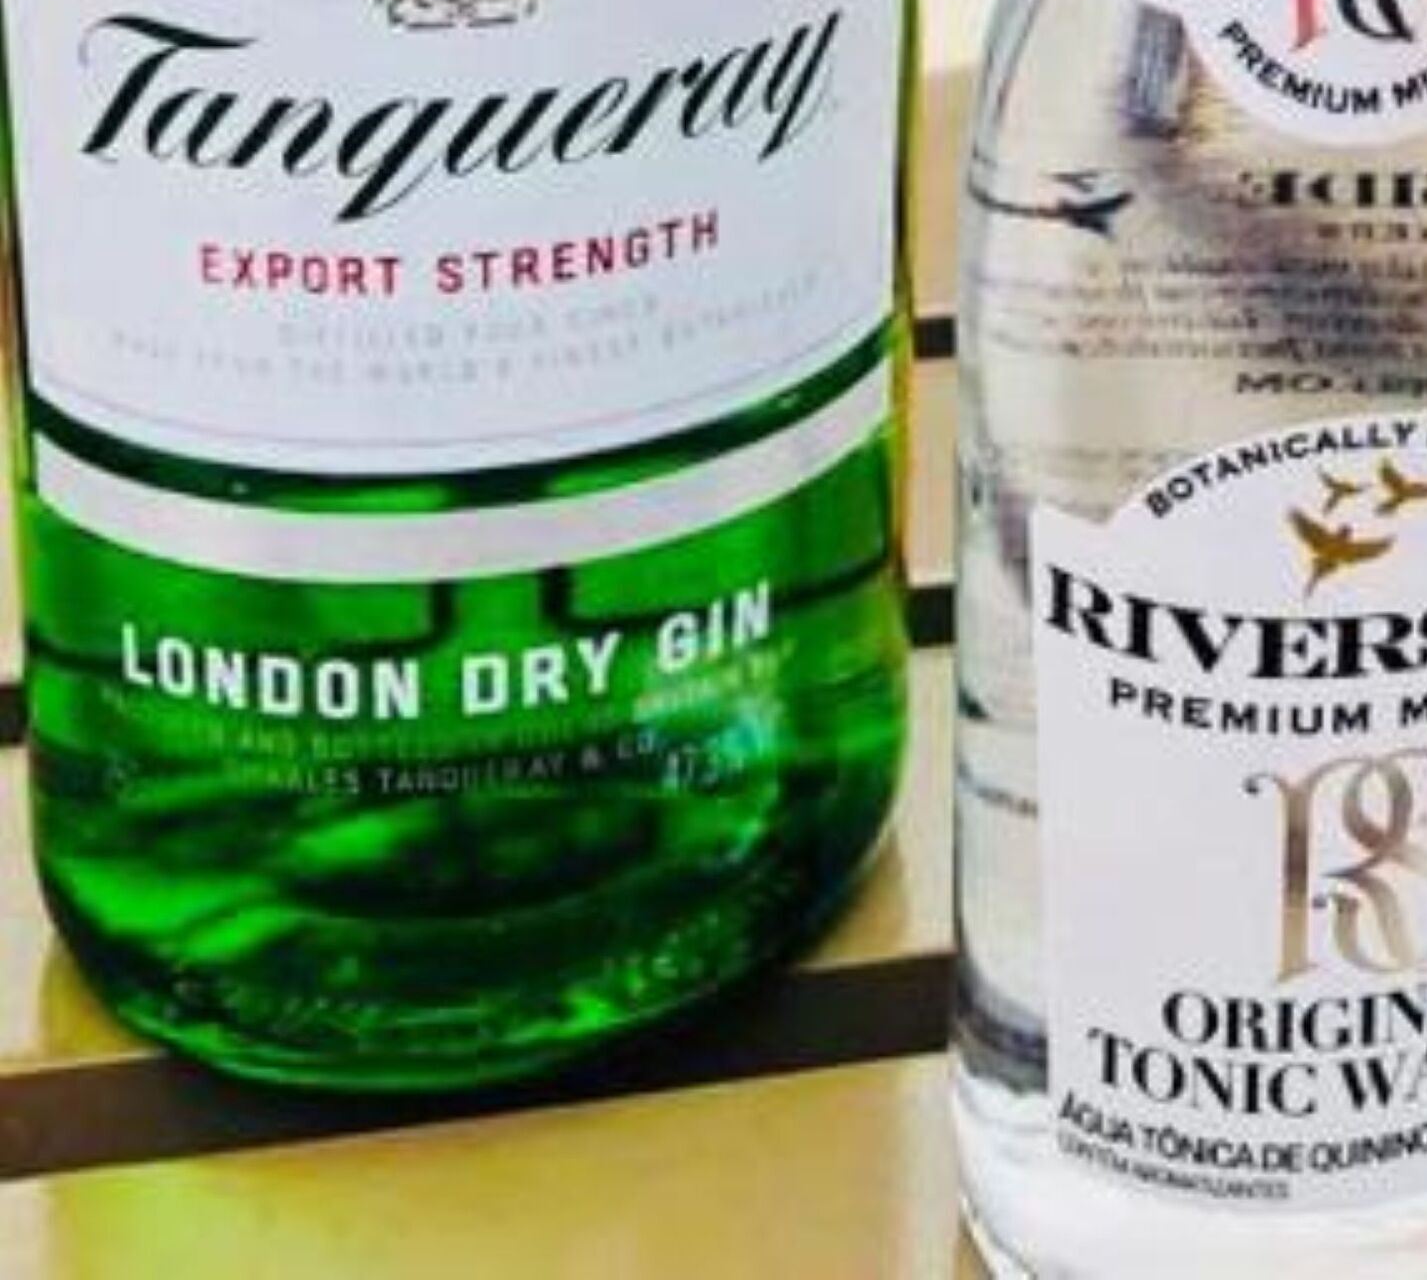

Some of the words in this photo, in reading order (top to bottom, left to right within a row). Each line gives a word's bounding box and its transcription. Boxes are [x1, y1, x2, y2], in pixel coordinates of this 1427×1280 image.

[1217, 19, 1382, 114] PREMIUM
[78, 8, 843, 224] Tanqueray
[199, 242, 403, 296] EXPORT
[436, 211, 721, 295] STRENGTH
[1147, 421, 1418, 519] BOTANICALLY
[121, 623, 421, 720] LONDON
[461, 631, 620, 717] DRY
[655, 580, 771, 675] GIN
[1110, 677, 1371, 737] PREMIUM
[1087, 1027, 1318, 1118] TONIC
[1139, 1123, 1253, 1169] TÔNICA
[1262, 1142, 1304, 1174] DE
